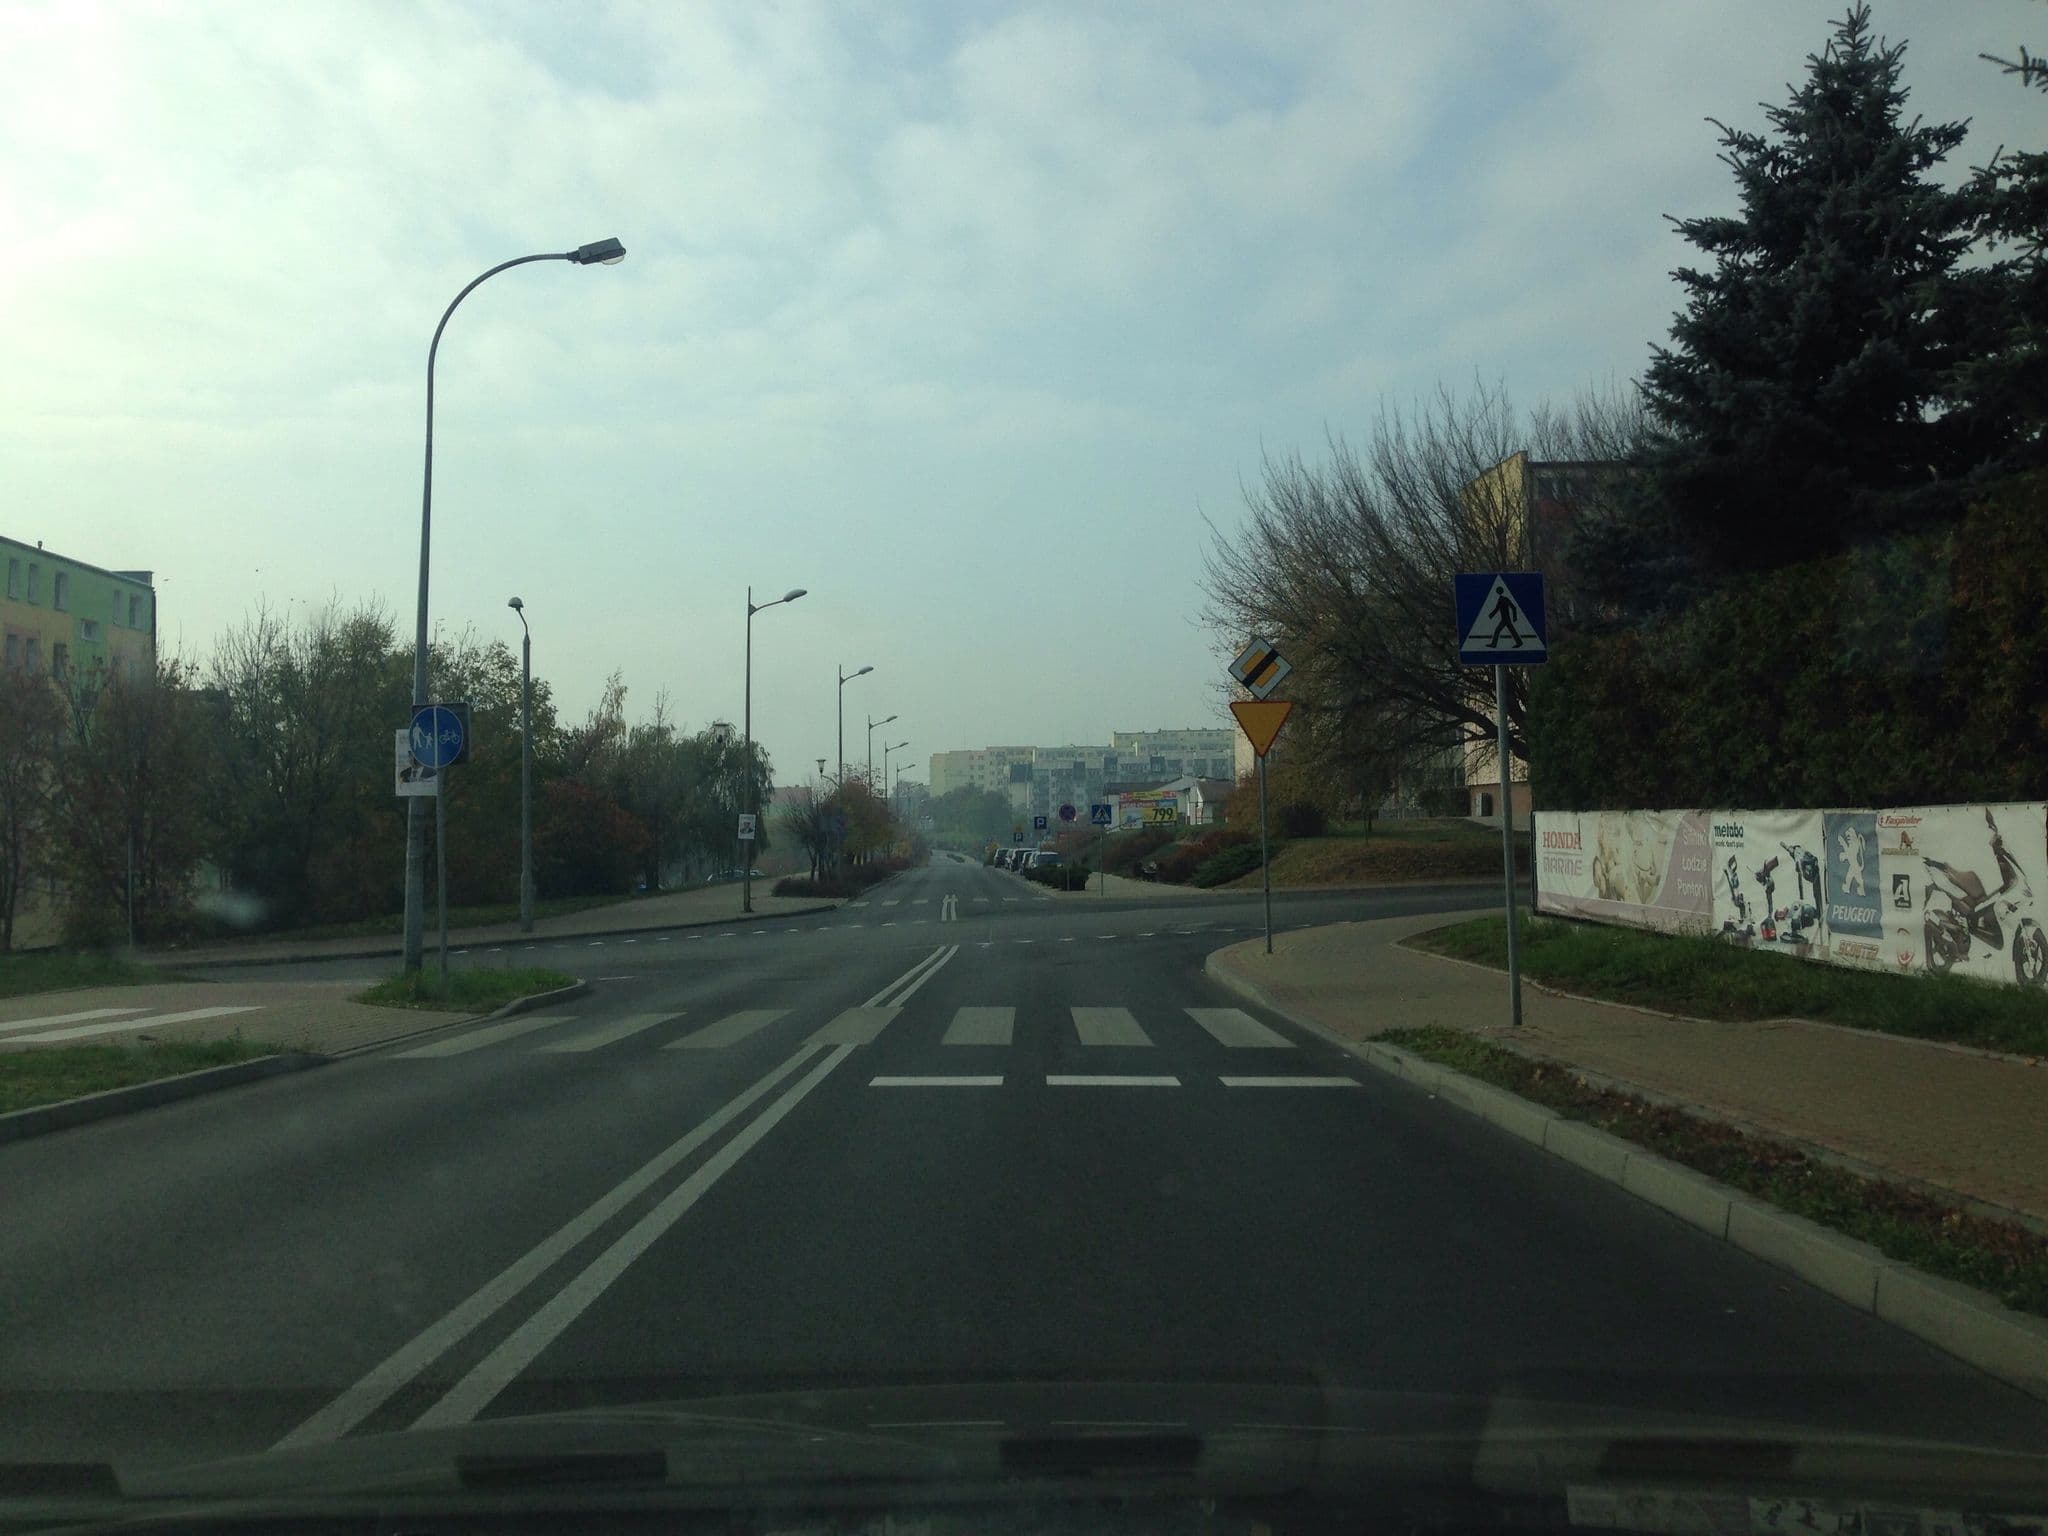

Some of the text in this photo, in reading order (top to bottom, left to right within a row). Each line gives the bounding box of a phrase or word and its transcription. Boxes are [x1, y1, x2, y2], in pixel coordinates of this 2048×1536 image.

[1153, 808, 1173, 820] 799
[1714, 822, 1744, 838] metabo
[1543, 832, 1581, 849] HONDA
[1543, 857, 1583, 876] MARINE
[1832, 904, 1877, 924] PEUGEOT
